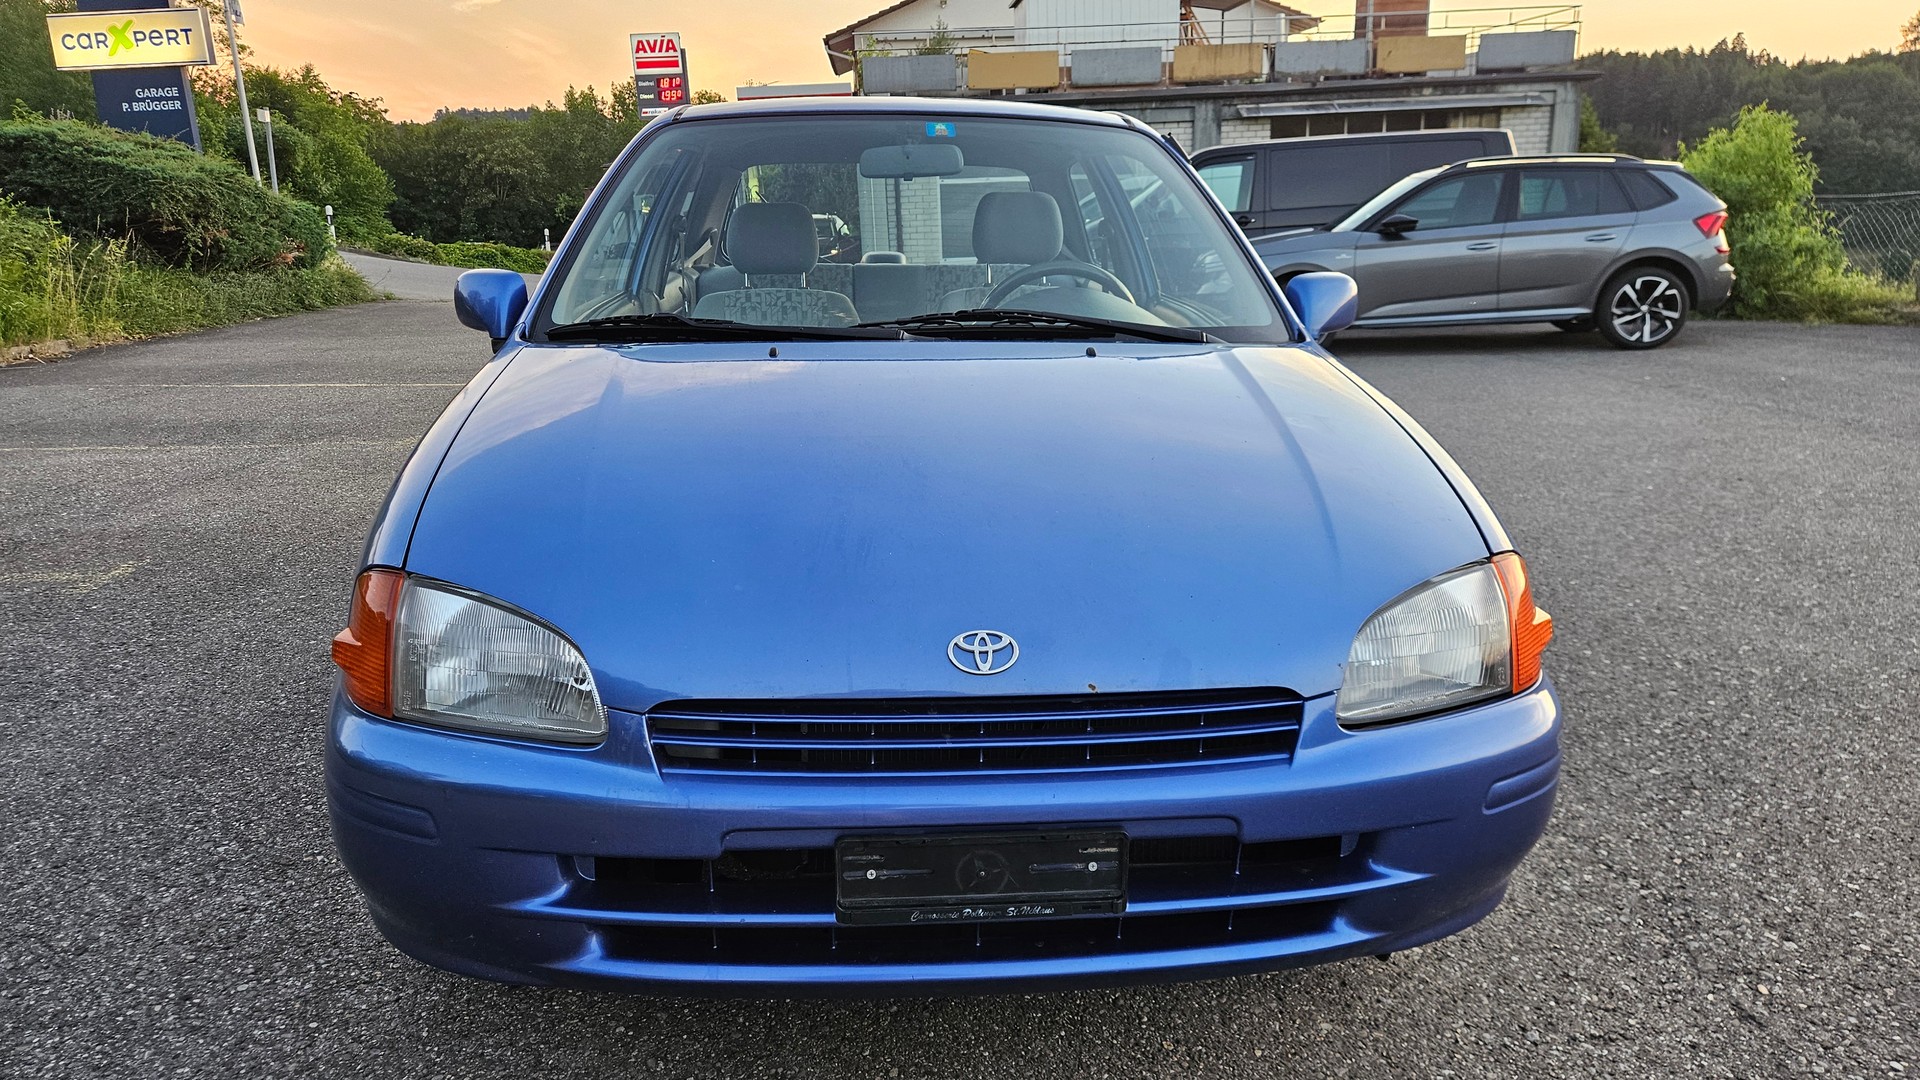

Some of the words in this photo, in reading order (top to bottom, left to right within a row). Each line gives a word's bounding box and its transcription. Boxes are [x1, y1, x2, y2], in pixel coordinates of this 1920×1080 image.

[135, 87, 180, 99] GARAGE
[122, 102, 131, 112] P.
[133, 99, 182, 112] BRÜGGER
